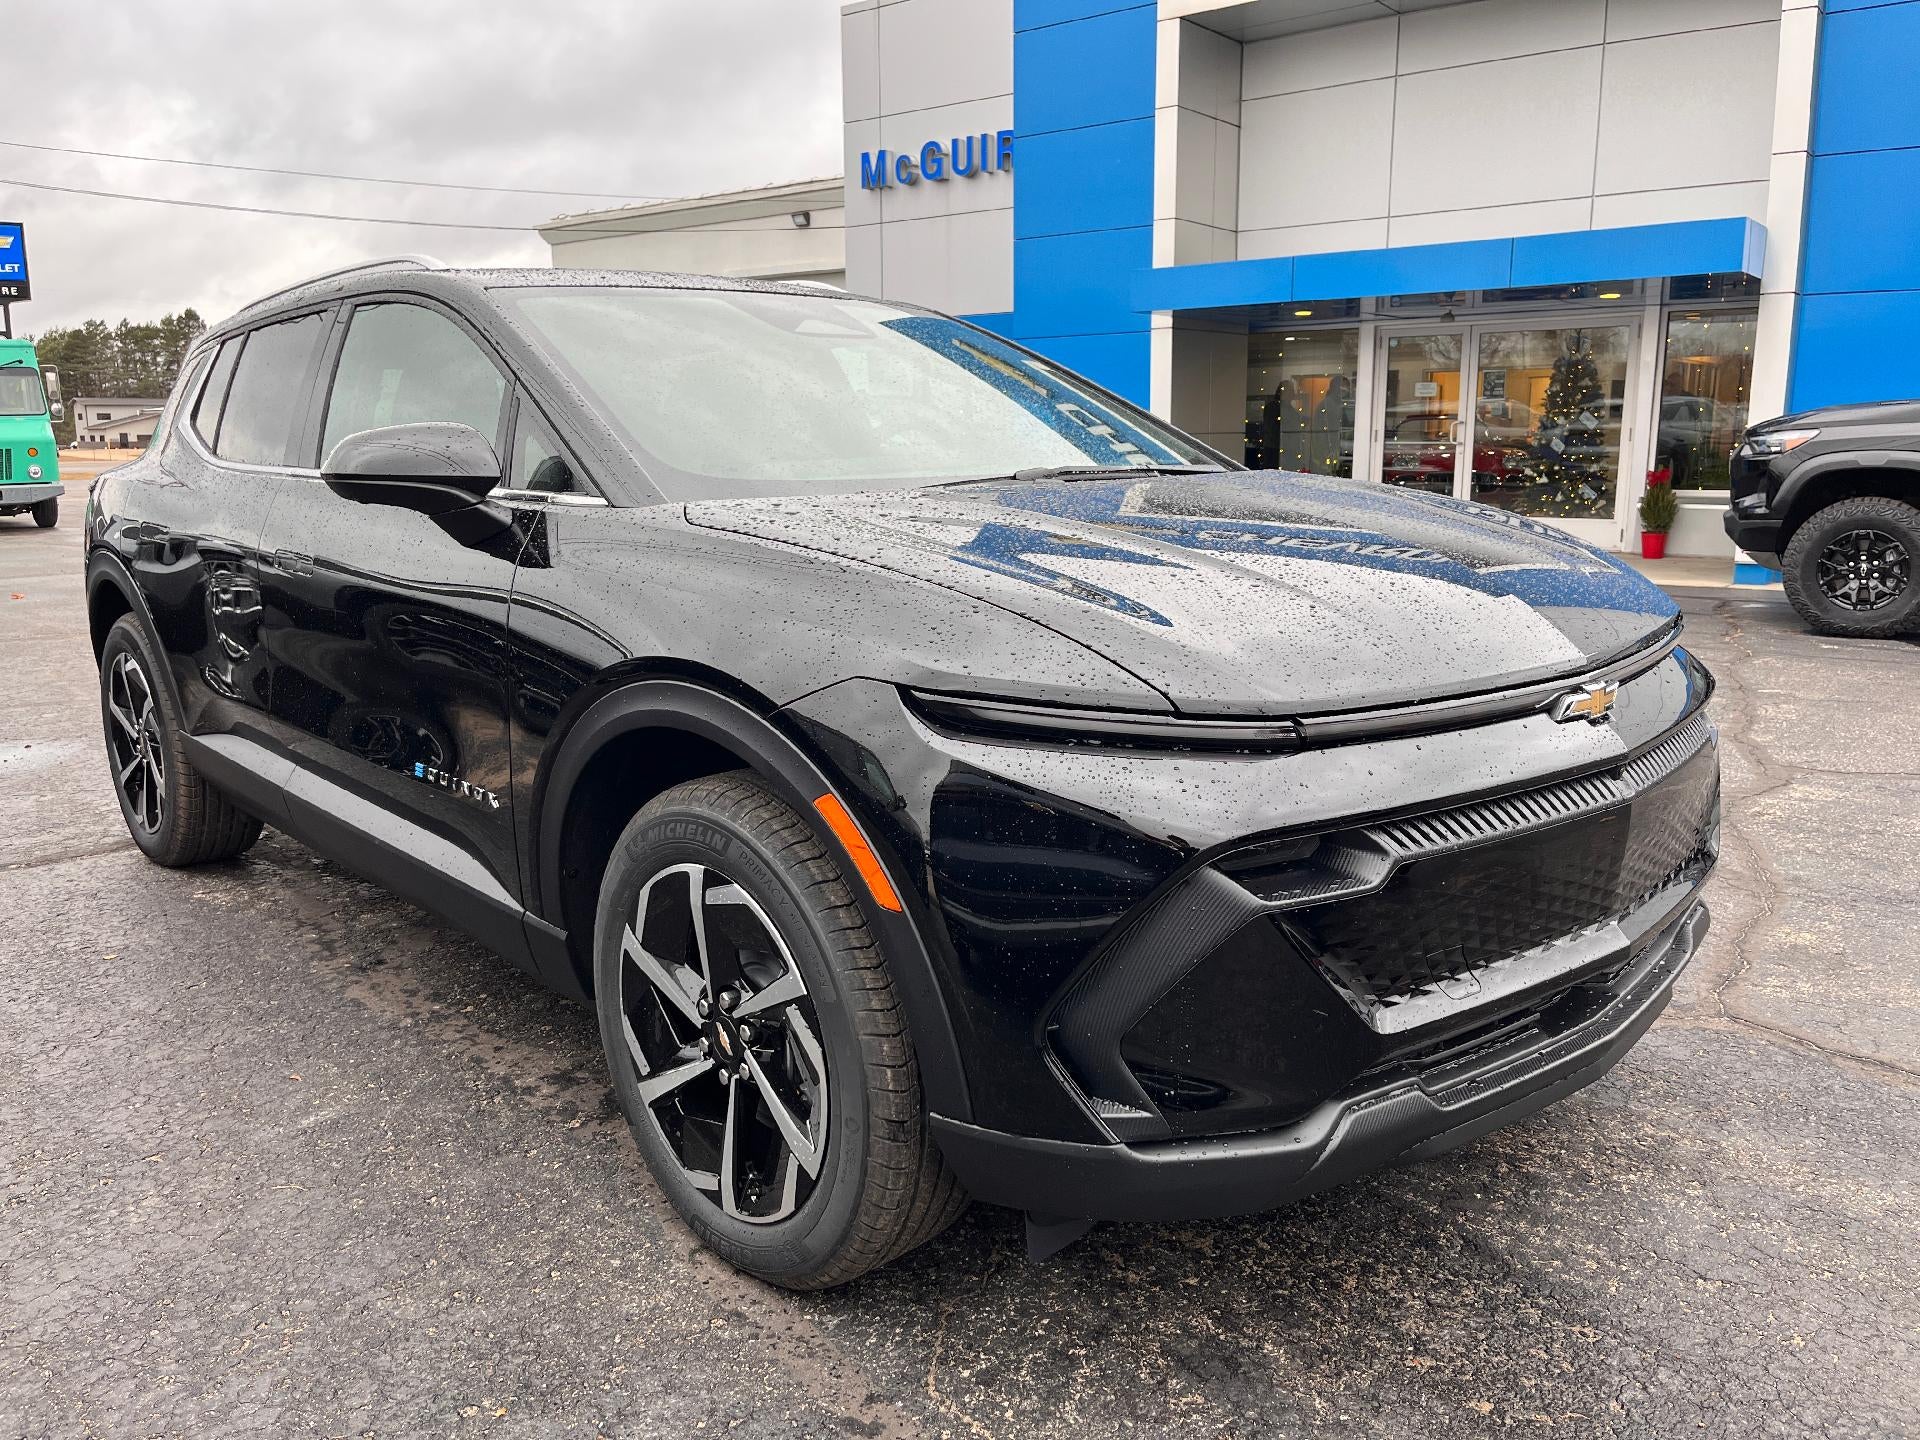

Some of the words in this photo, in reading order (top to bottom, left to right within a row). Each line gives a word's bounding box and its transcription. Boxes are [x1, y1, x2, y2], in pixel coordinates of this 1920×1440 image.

[1, 286, 18, 296] RE
[414, 762, 500, 809] EQUINOX
[649, 821, 727, 852] MICHELIN
